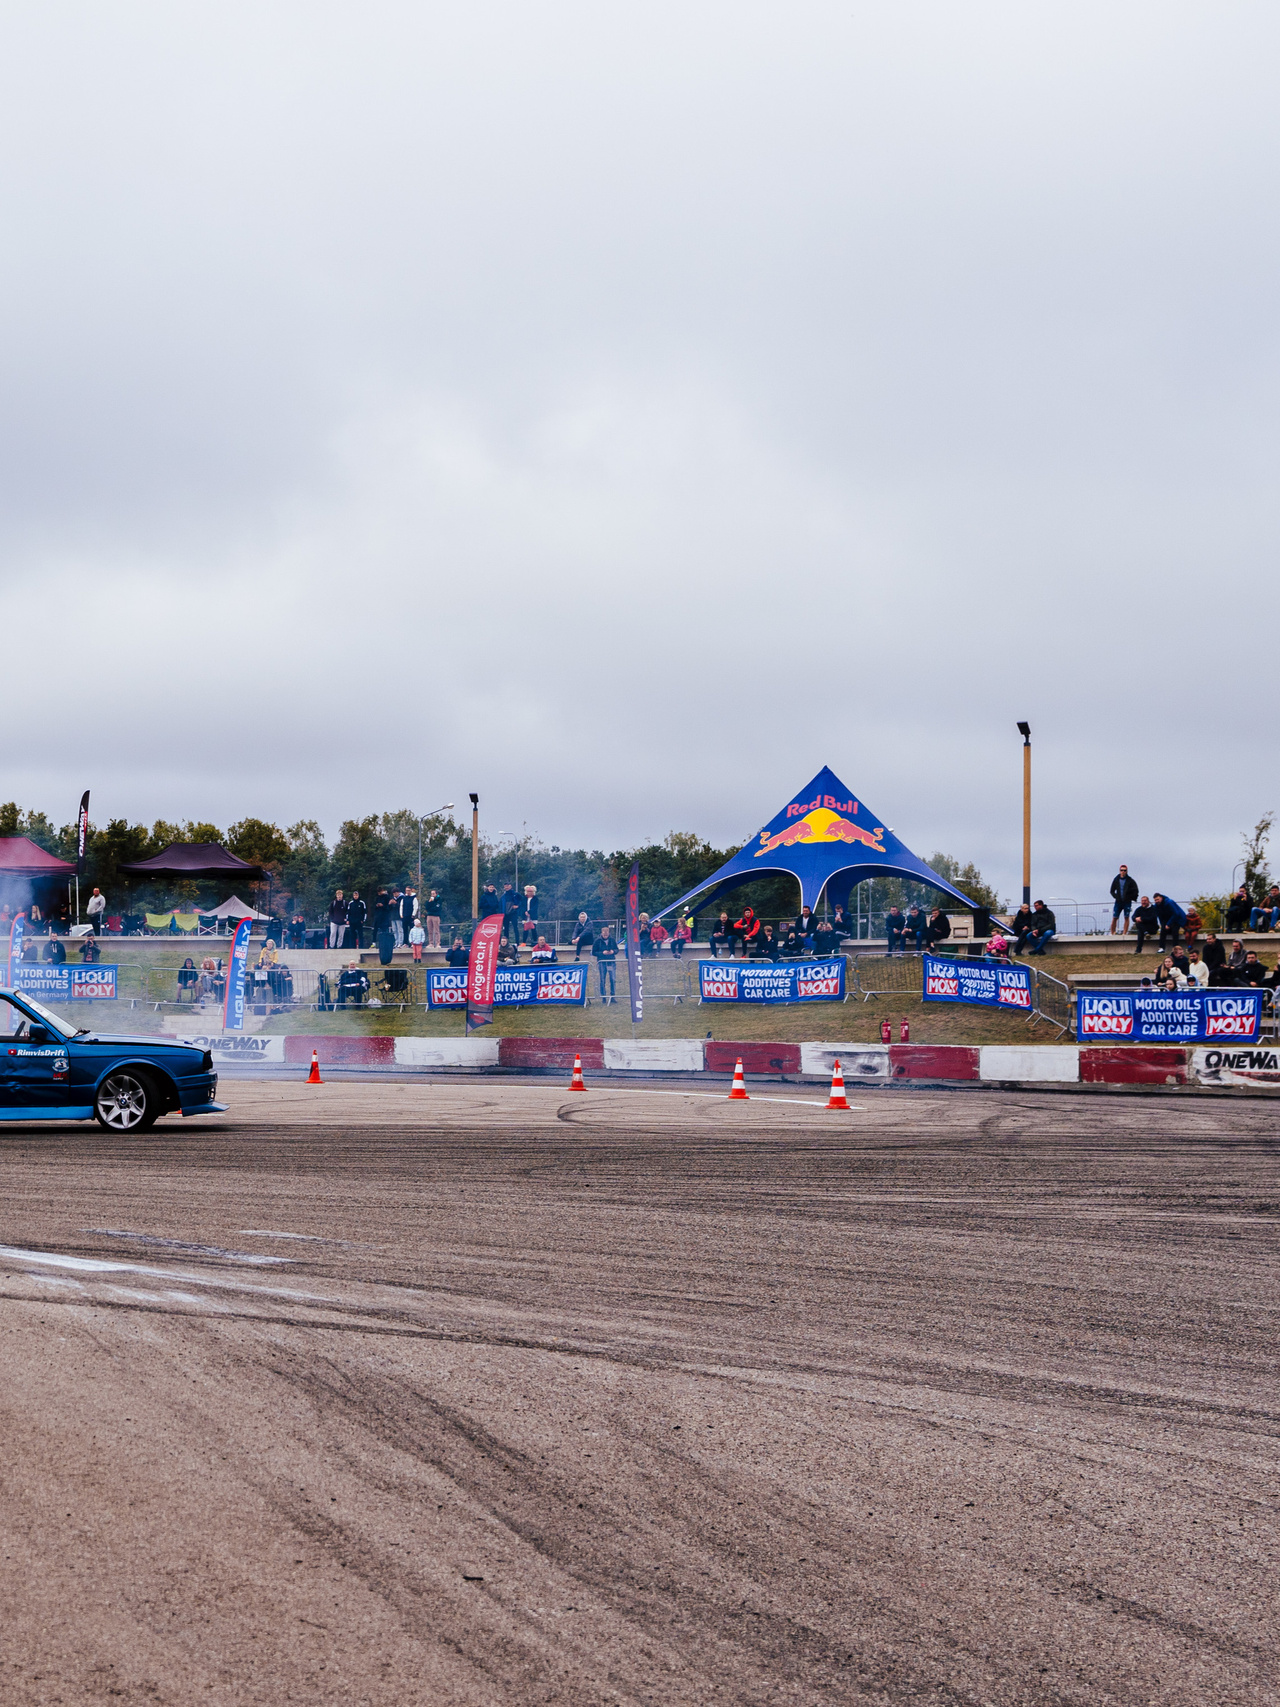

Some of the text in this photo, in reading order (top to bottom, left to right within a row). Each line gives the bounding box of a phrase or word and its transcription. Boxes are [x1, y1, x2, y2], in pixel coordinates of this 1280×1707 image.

[786, 795, 858, 818] Red Bull
[47, 969, 69, 978] OILS
[75, 970, 113, 983] LIQUI
[472, 941, 487, 1000] ovigreta.lt
[513, 972, 535, 981] OILS
[704, 967, 736, 982] LIQUI
[740, 968, 795, 977] MOTOR OILS
[799, 965, 838, 980] LIQUI
[958, 967, 996, 980] MOTOR OILS
[433, 976, 467, 989] LIQU
[540, 971, 580, 985] LIQUI
[743, 978, 790, 987] ADDITIVES
[999, 972, 1026, 988] LIQUI
[75, 984, 113, 996] MOLY
[494, 983, 532, 992] DITIVES
[539, 985, 581, 998] MOLY
[704, 982, 737, 997] MOLY
[799, 980, 838, 996] MOLY
[928, 978, 958, 993] MOLY
[36, 991, 68, 1000] Germany
[504, 992, 530, 1001] CARE
[744, 988, 790, 998] CAR CARE
[1000, 989, 1028, 1004] MOLY
[234, 981, 244, 1029] LIQUI
[1085, 999, 1129, 1016] LIQUI
[1135, 999, 1201, 1010] MOTOR OILS
[1208, 999, 1254, 1016] LIQUI
[1085, 1016, 1132, 1032] MOLY
[1141, 1012, 1198, 1023] ADDITIVES
[1142, 1024, 1197, 1035] CAR CARE
[1208, 1017, 1255, 1034] MOLY
[1205, 1051, 1280, 1069] ONEWA
